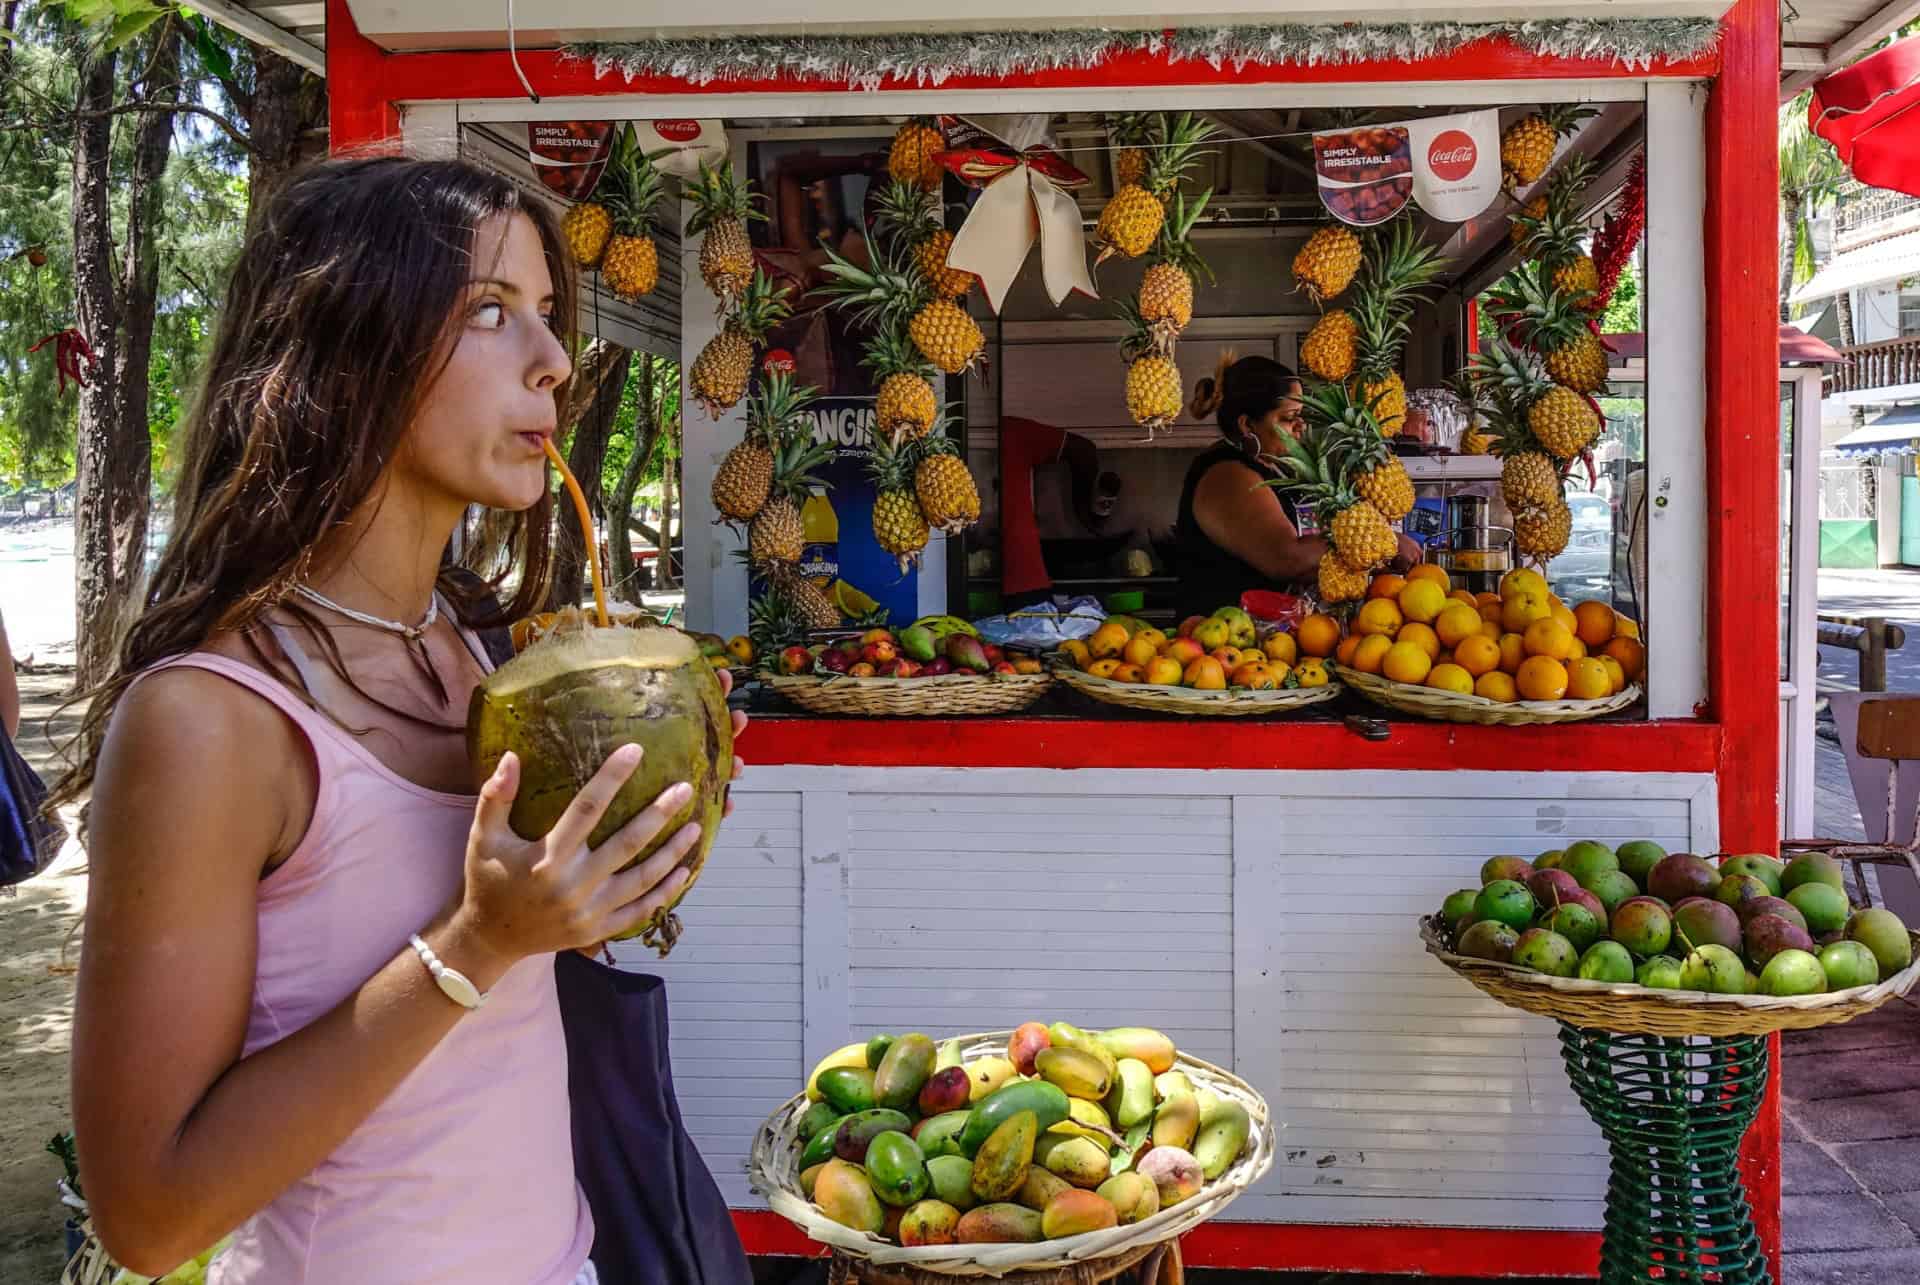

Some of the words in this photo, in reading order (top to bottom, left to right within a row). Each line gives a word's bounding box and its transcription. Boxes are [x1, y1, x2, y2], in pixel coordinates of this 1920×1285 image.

[535, 127, 568, 136] SIMPLY
[1323, 147, 1357, 158] SIMPLY
[1324, 154, 1392, 168] IRRESISTABLE
